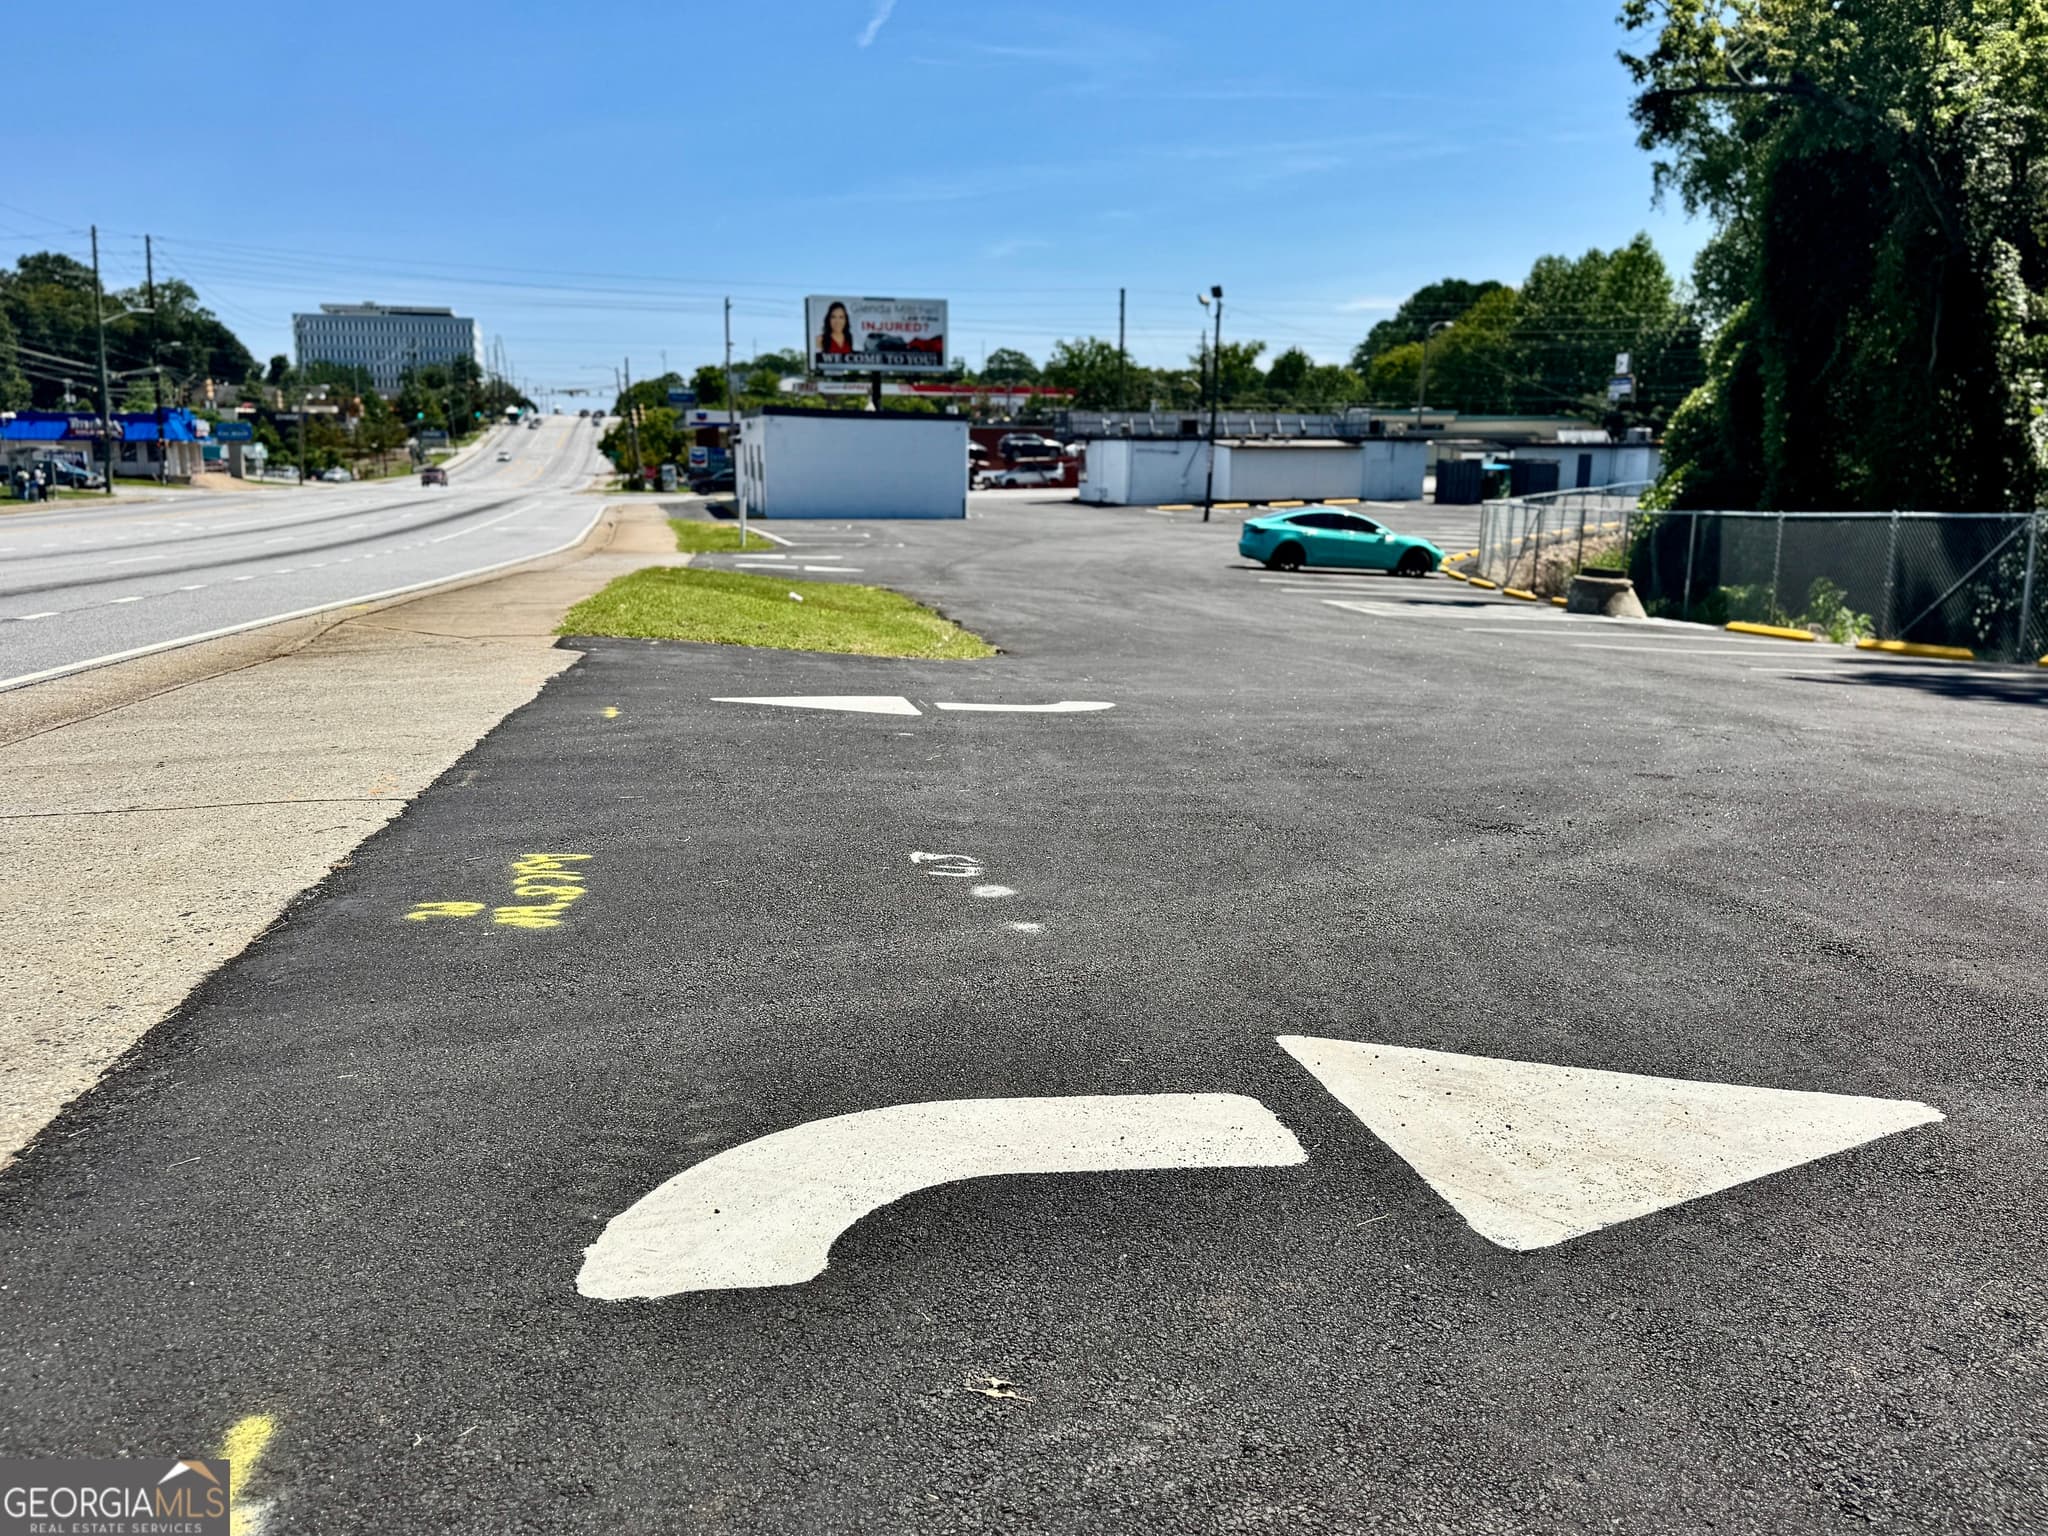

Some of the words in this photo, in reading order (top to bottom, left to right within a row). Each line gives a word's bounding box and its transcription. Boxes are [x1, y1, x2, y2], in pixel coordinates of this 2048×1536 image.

[861, 321, 929, 332] INJURED?
[822, 353, 842, 363] WE
[844, 353, 883, 364] COME
[887, 354, 902, 364] TO
